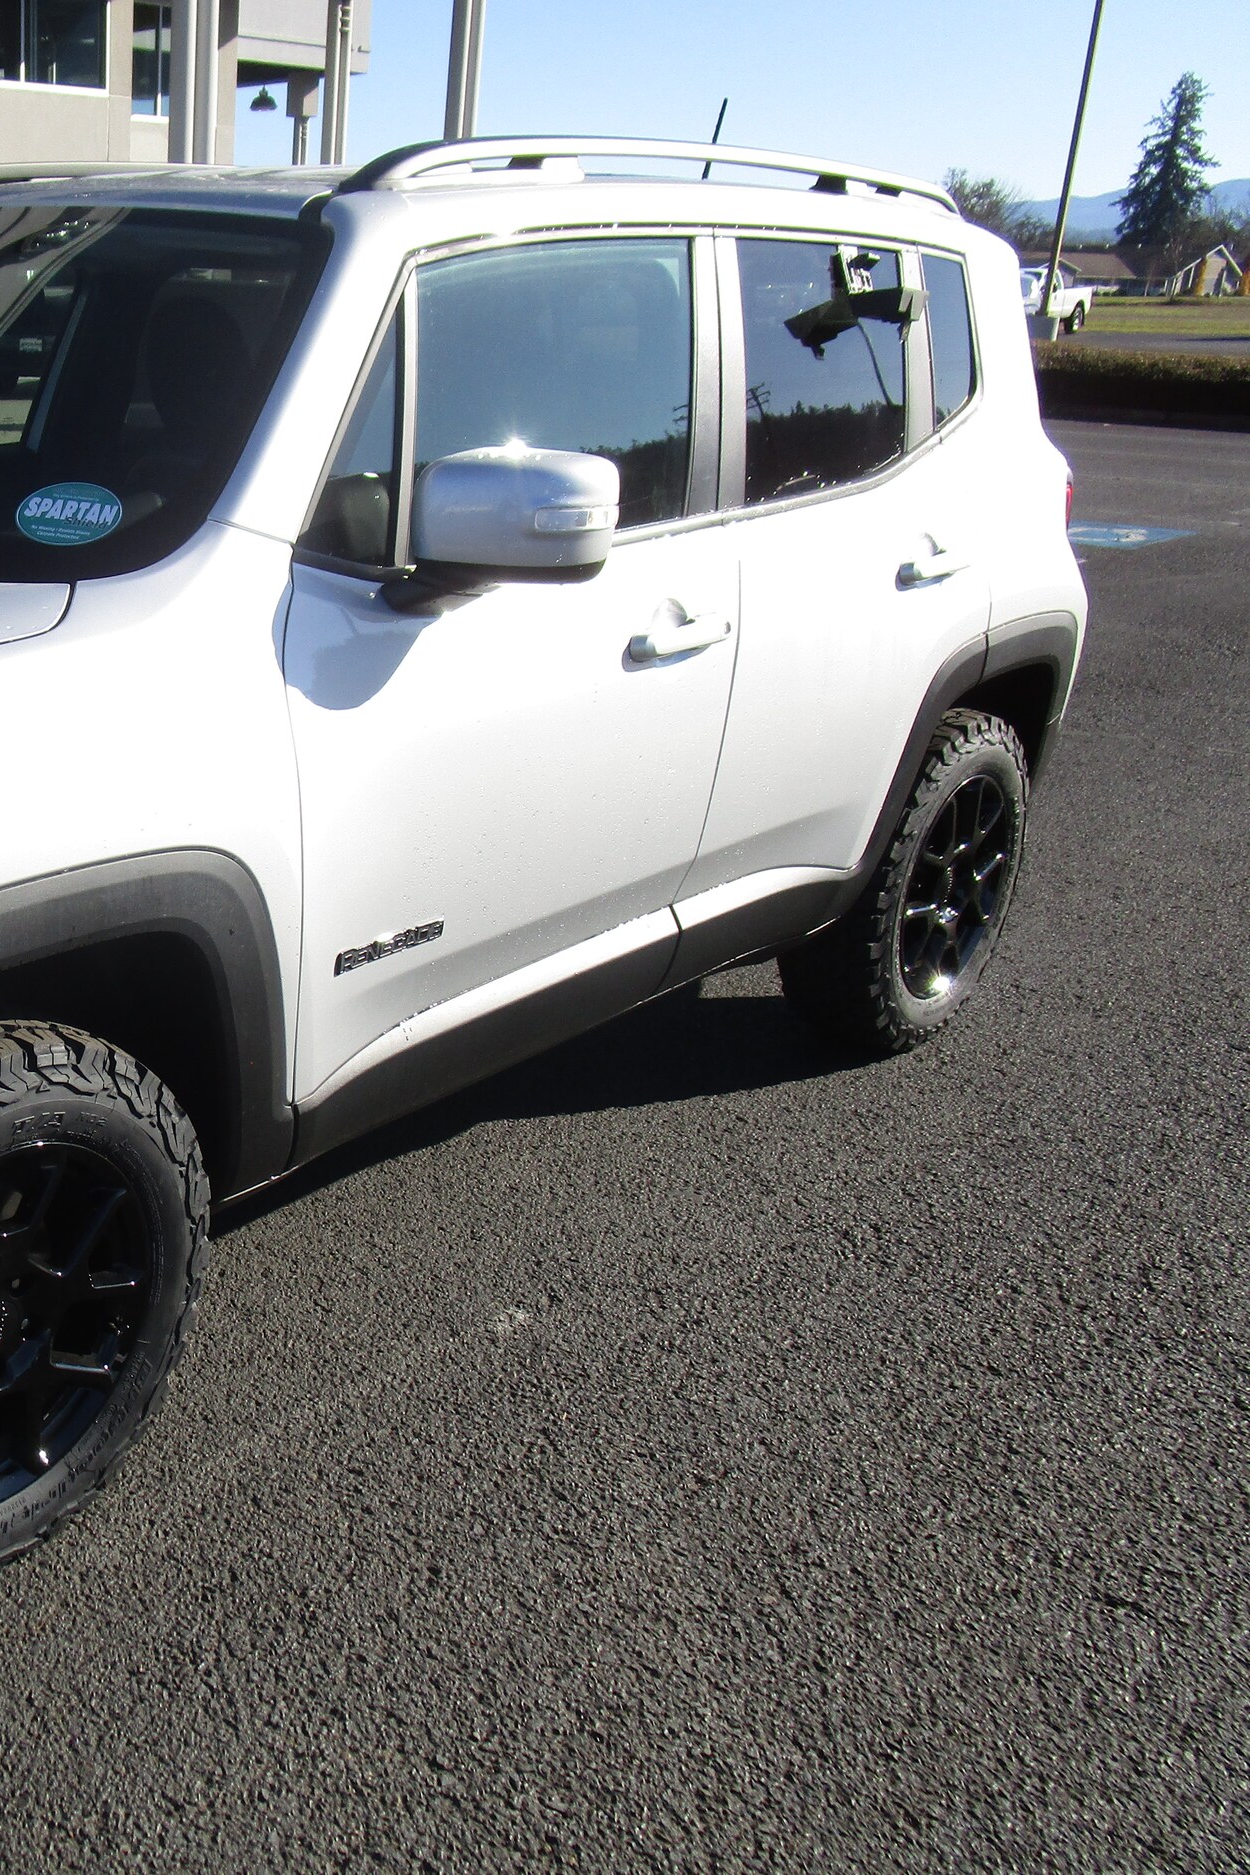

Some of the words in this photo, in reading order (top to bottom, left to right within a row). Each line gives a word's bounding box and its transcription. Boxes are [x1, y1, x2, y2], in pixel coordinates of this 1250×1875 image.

[23, 497, 119, 526] SPARTAN
[63, 516, 109, 529] Shield
[334, 916, 446, 978] RENEGADE
[13, 1110, 67, 1136] T/A
